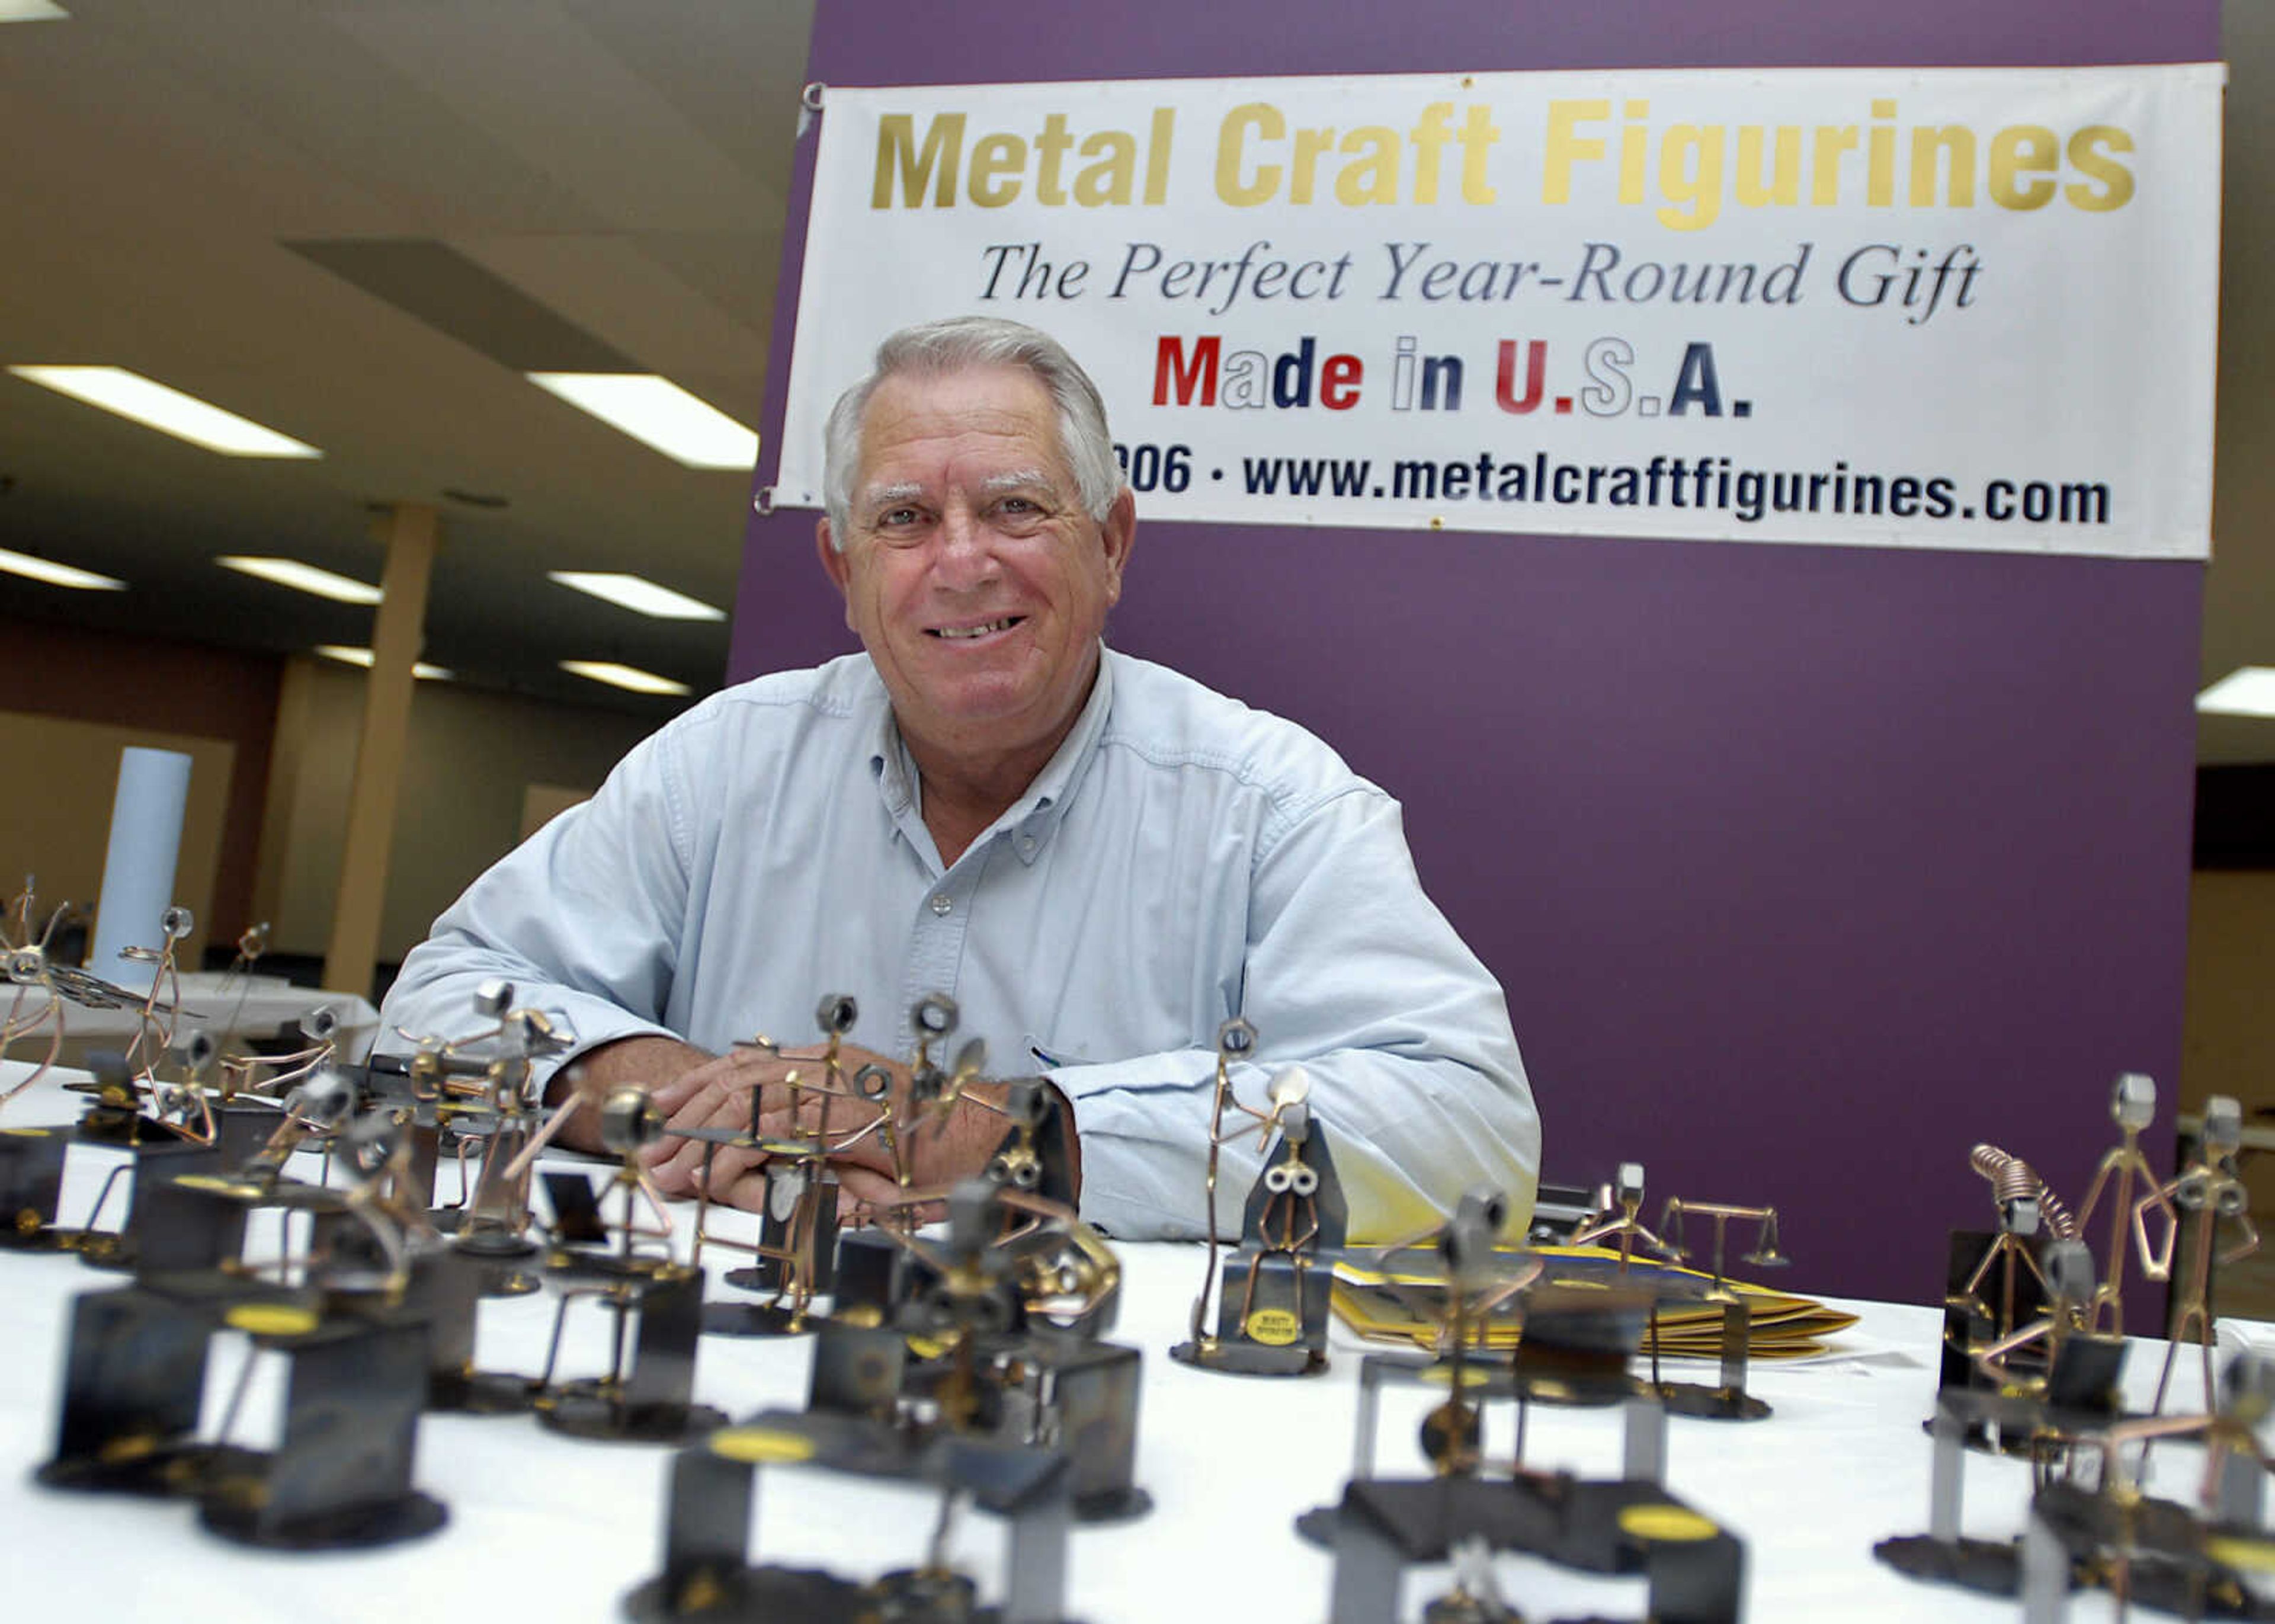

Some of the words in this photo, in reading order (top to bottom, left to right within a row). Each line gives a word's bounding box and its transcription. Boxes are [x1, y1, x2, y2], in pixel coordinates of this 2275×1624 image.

[871, 108, 1175, 210] Metal
[1214, 102, 1500, 207] Craft
[1542, 100, 2136, 231] Figurines
[980, 242, 1090, 300] The
[1108, 242, 1352, 316] Perfect
[1379, 243, 1813, 306] Year-Round
[1837, 244, 1982, 325] Gift
[1152, 335, 1364, 411] Made
[1392, 336, 1463, 411] in
[1495, 338, 1753, 418] U.S.A.
[1243, 453, 2111, 524] www.metalcraftfigurines.com
